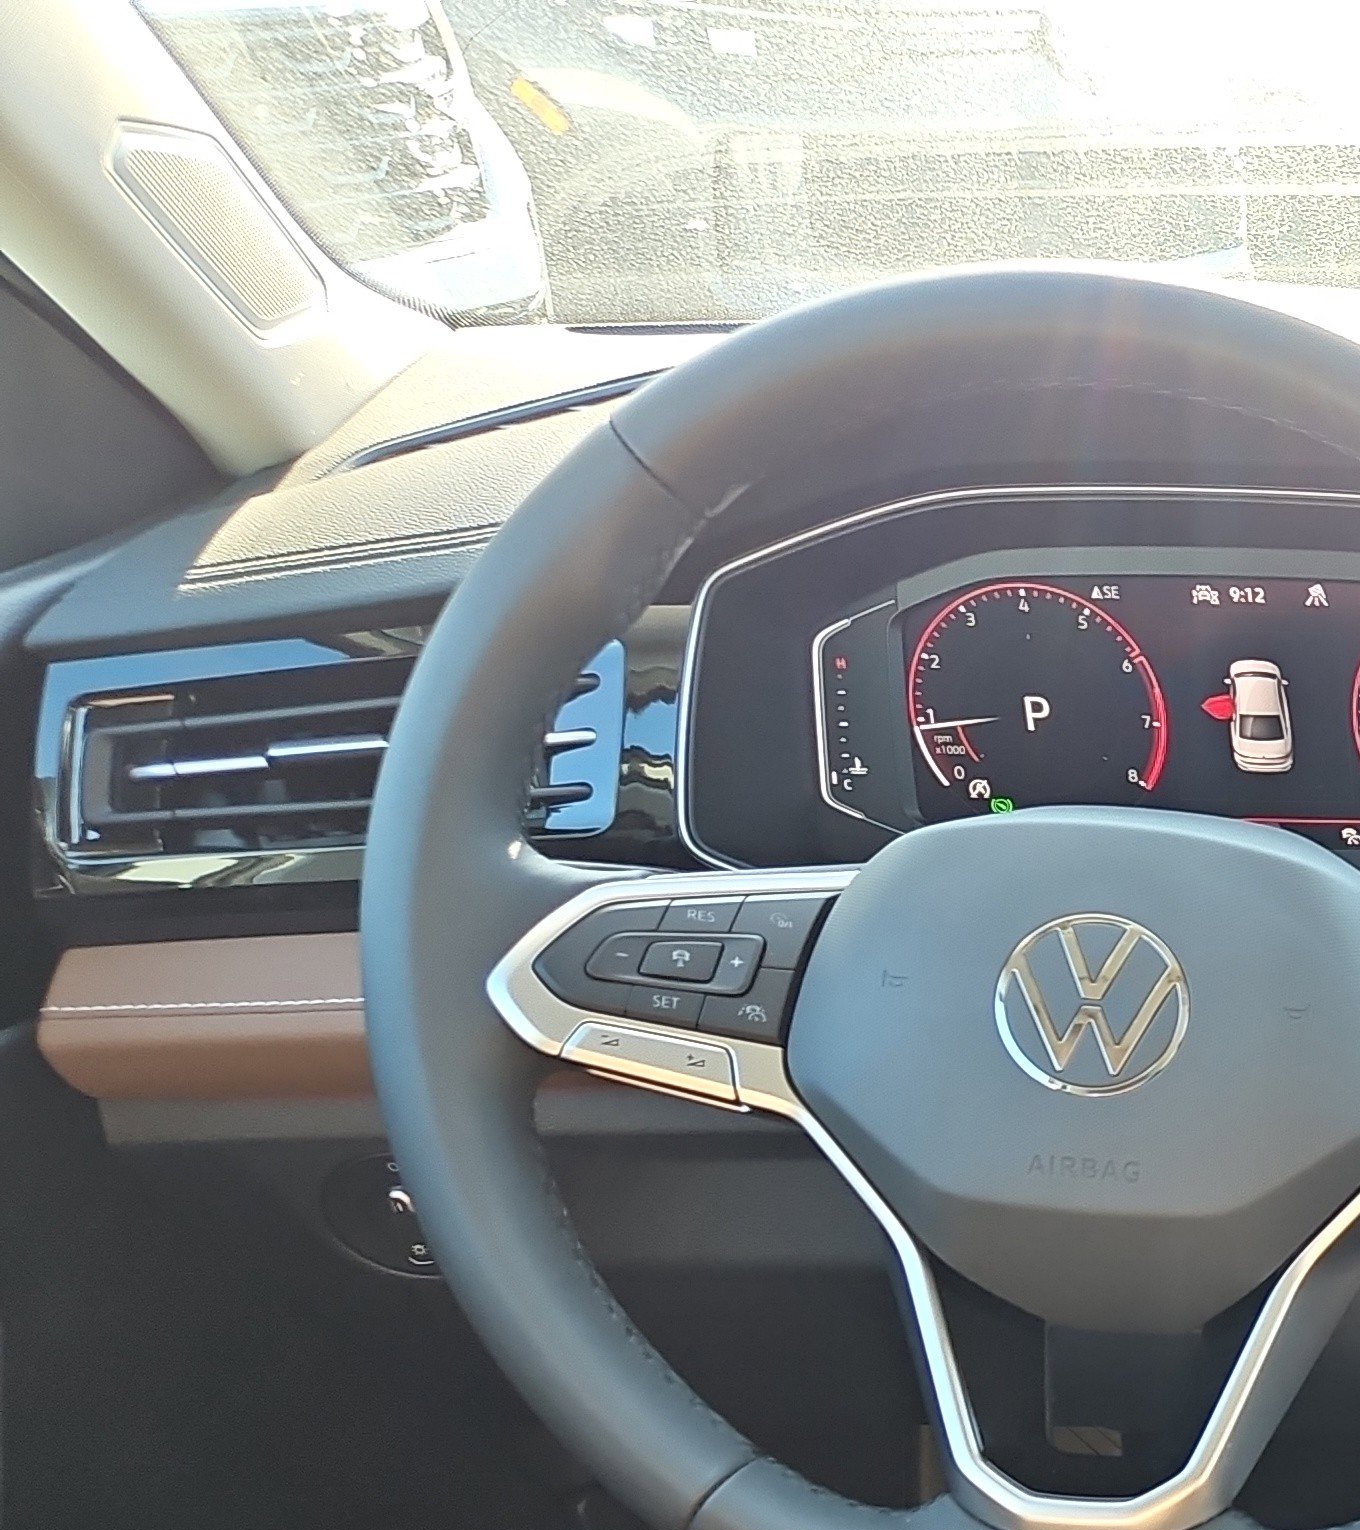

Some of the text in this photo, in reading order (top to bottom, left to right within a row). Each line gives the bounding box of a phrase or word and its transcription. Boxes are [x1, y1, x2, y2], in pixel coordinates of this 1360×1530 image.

[1229, 587, 1266, 604] 9:12
[1018, 599, 1030, 613] 4
[965, 612, 976, 627] 3
[1077, 615, 1088, 630] 5
[929, 654, 941, 669] 2
[1122, 659, 1133, 673] 6
[1023, 695, 1050, 731] P
[1141, 714, 1151, 729] 7
[933, 735, 953, 745] rpm
[935, 745, 966, 755] x1000
[954, 766, 965, 780] 0
[1127, 769, 1139, 783] 8
[843, 779, 853, 791] C
[687, 909, 715, 923] RES
[652, 994, 681, 1009] SET
[1027, 1154, 1141, 1183] AIRBAG
